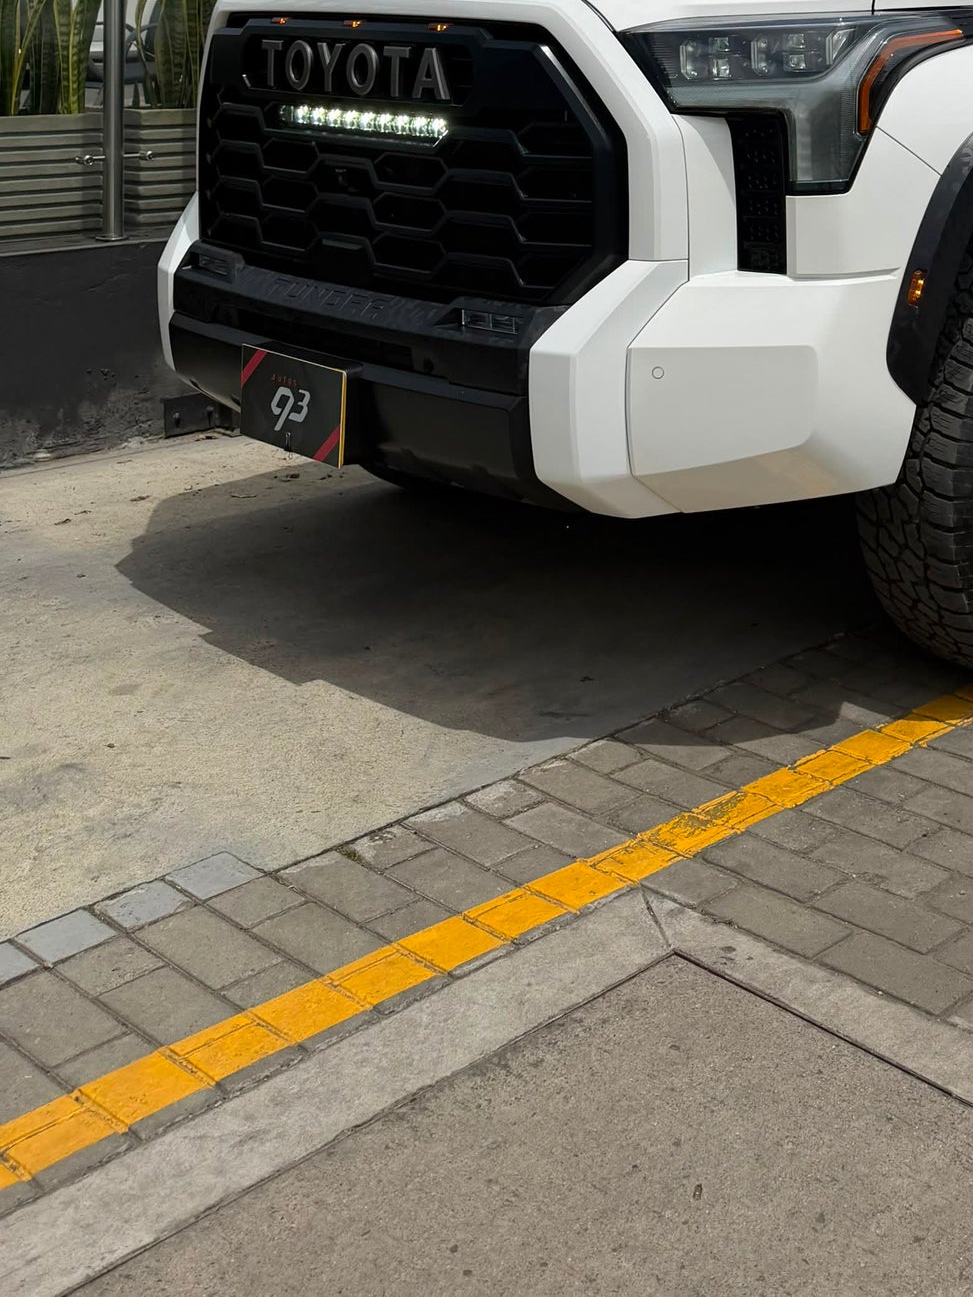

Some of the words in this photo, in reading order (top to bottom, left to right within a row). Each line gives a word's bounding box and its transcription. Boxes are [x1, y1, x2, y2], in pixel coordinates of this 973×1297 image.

[261, 39, 450, 101] TOYOTA
[267, 277, 391, 320] TUNDRA
[270, 386, 311, 432] 93
